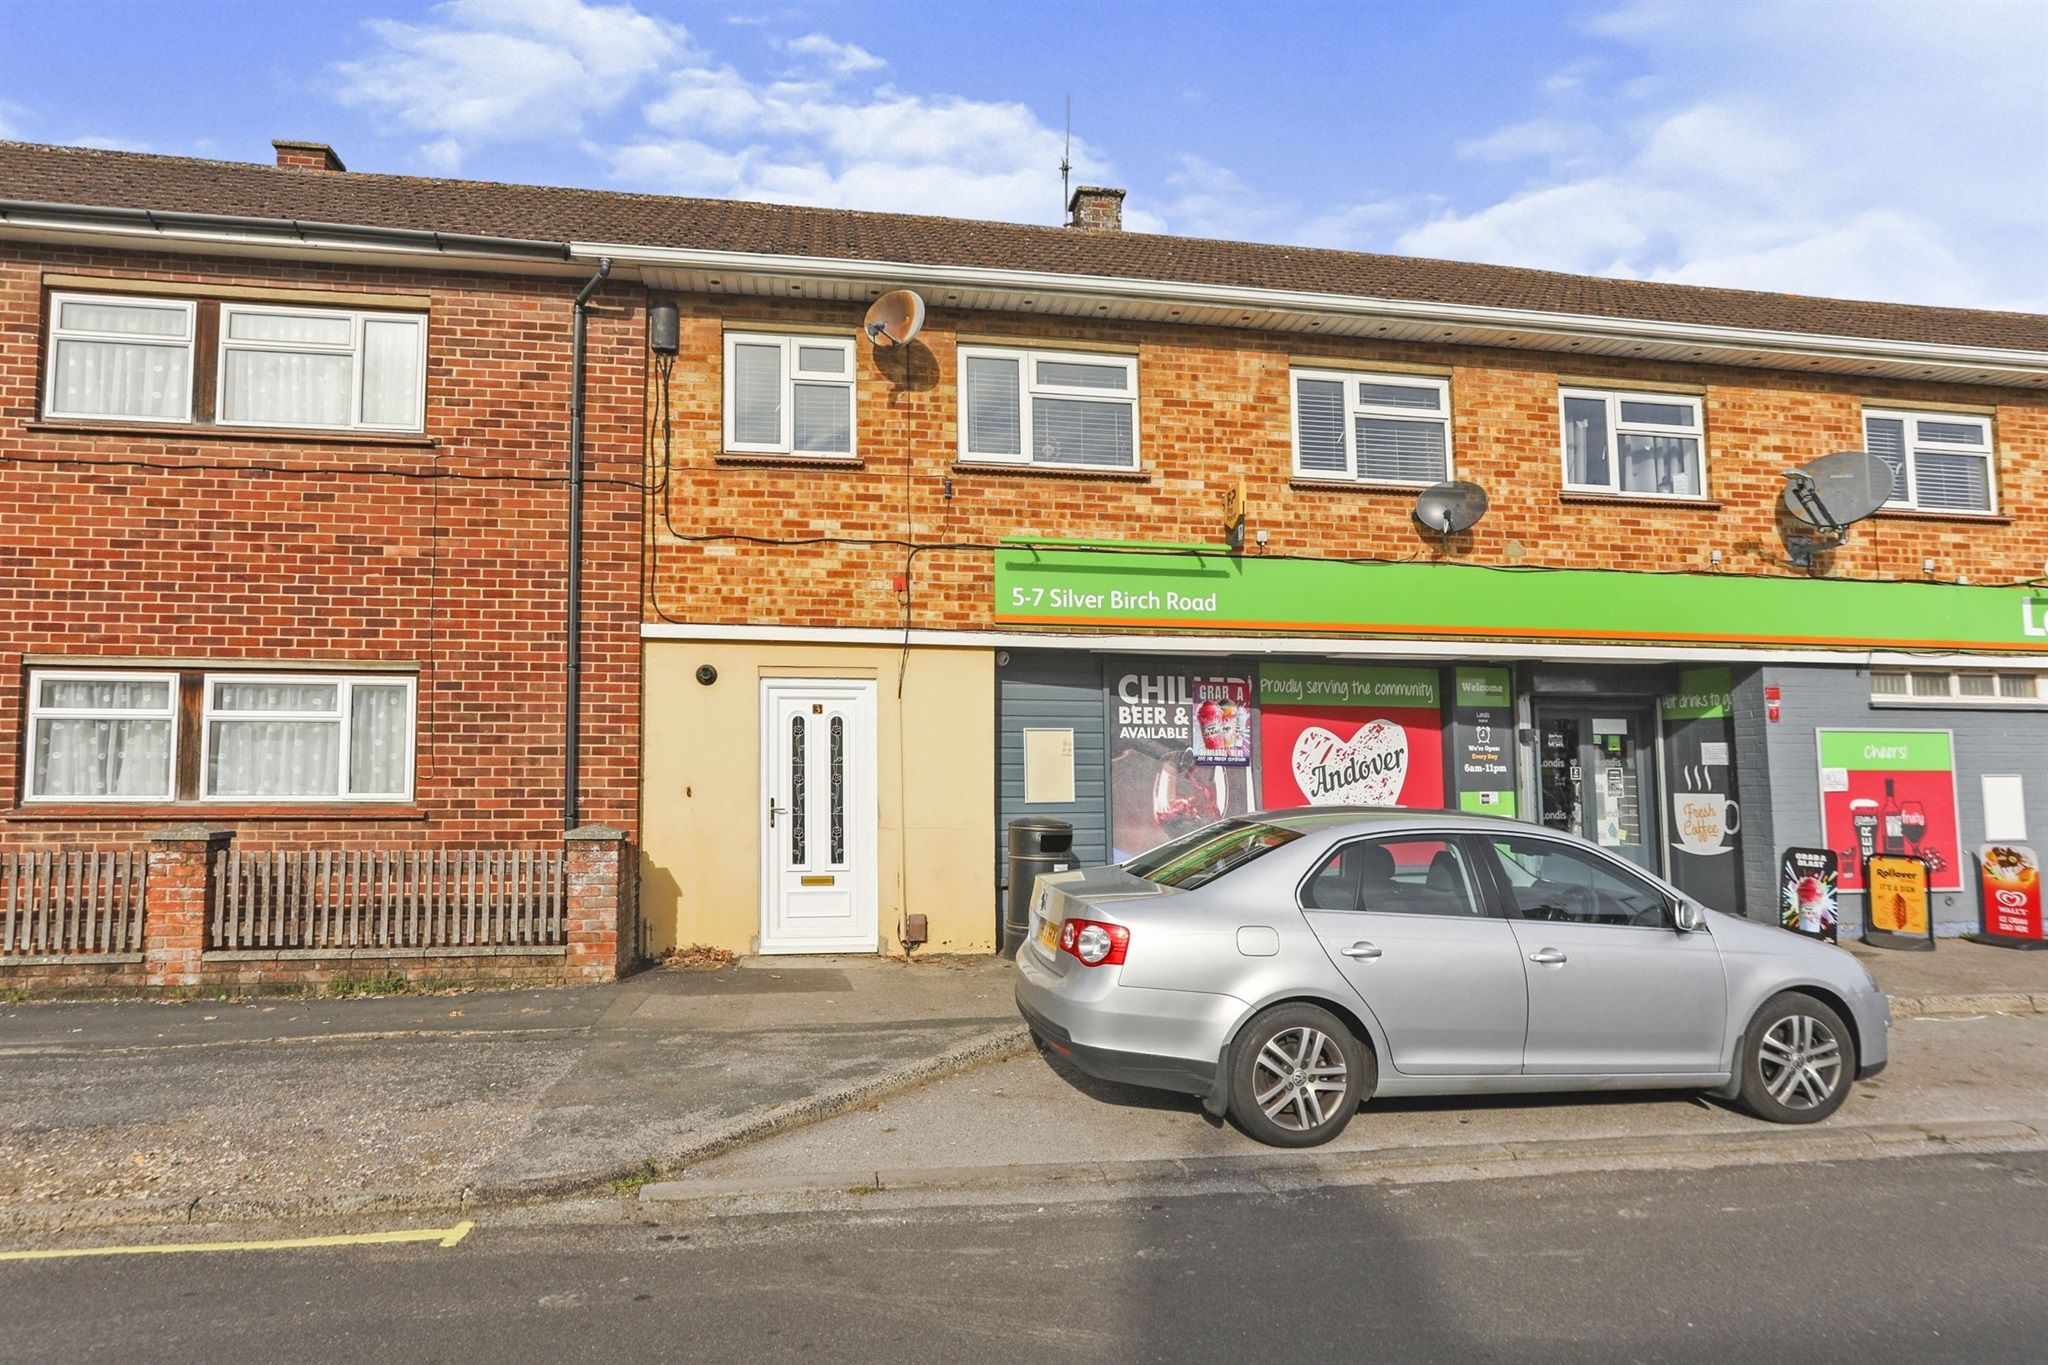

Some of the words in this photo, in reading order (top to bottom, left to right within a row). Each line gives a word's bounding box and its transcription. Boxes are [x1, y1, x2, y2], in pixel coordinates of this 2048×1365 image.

[1012, 587, 1044, 607] 5-7
[1050, 588, 1104, 609] Silver
[1110, 590, 1161, 610] Birch
[1167, 592, 1216, 612] Road
[2022, 596, 2048, 636] L
[1237, 686, 1244, 701] A
[1260, 678, 1303, 700] Proudly
[1307, 680, 1349, 701] serving
[1352, 681, 1371, 695] the
[1375, 682, 1434, 703] community
[1461, 682, 1503, 692] Welcome
[1679, 693, 1708, 708] drinks
[1710, 692, 1720, 706] to
[814, 704, 822, 714] 3
[1119, 706, 1167, 725] BEER
[1173, 707, 1190, 725] &
[1120, 727, 1189, 739] AVAILABLE
[1310, 748, 1405, 797] Andover
[1464, 763, 1508, 775] 6am-11pm
[1683, 801, 1717, 819] Fresh
[1684, 819, 1719, 842] Coffee
[1877, 868, 1918, 879] Rollover
